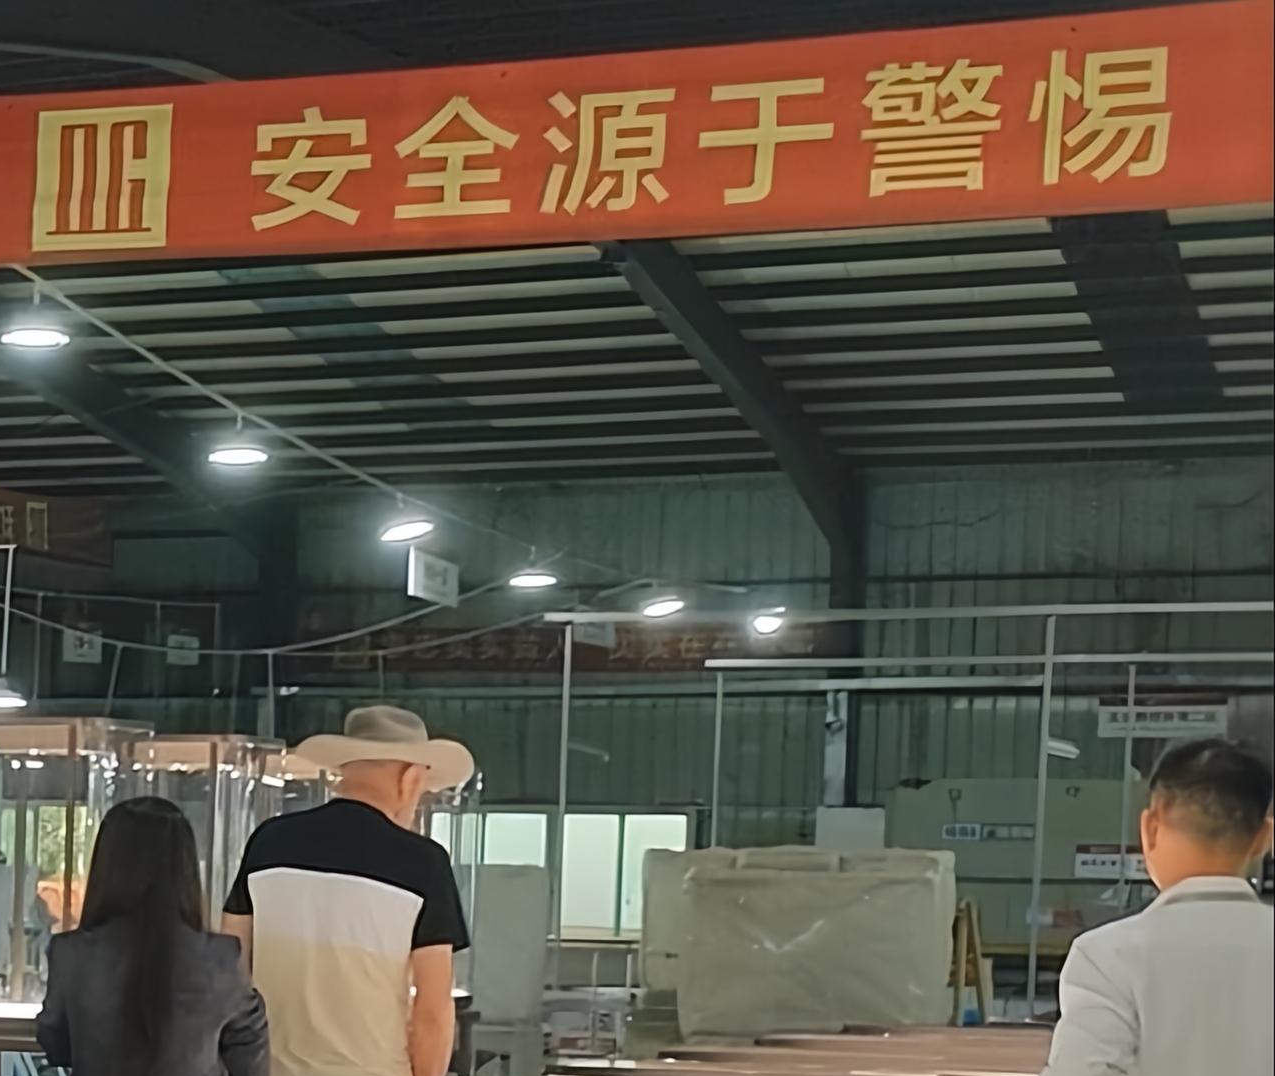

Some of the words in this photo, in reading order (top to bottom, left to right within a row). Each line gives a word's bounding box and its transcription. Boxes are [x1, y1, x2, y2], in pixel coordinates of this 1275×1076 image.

[250, 46, 1172, 232] 安全源于警惕
